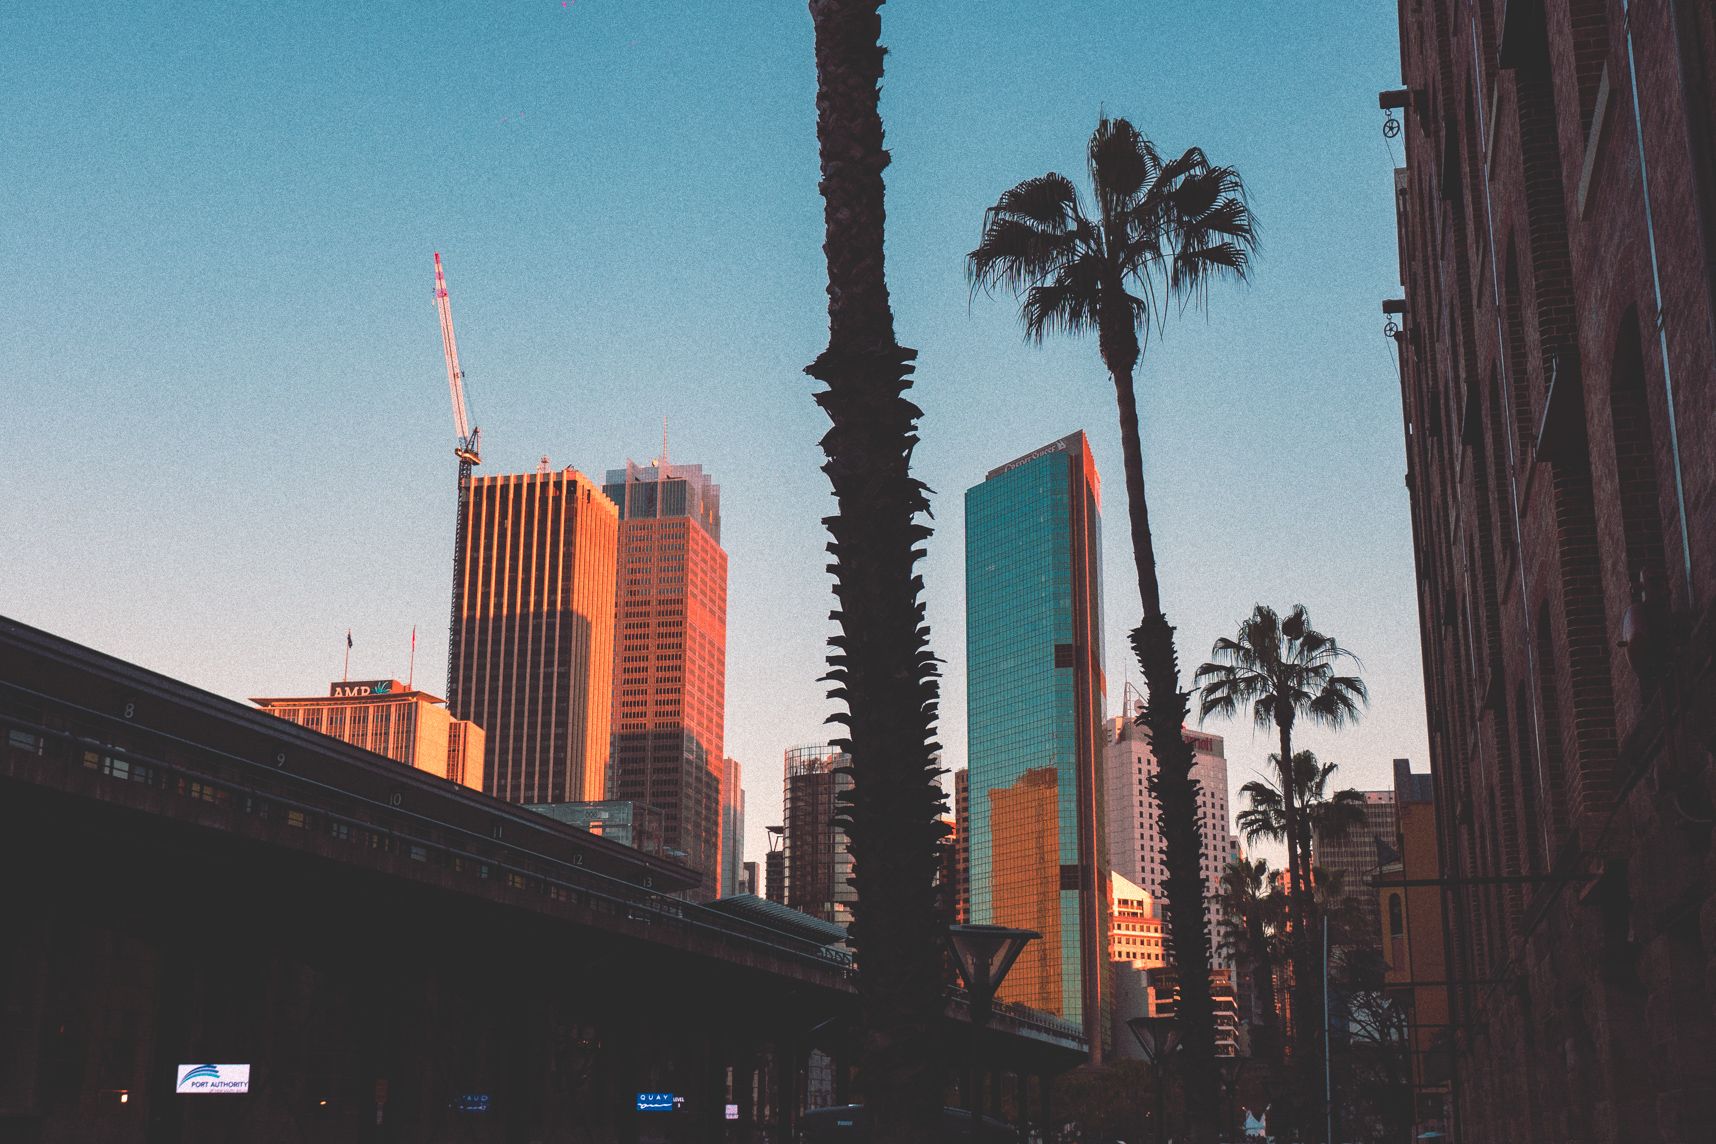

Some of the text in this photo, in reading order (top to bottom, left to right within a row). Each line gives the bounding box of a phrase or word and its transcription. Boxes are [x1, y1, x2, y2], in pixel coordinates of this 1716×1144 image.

[334, 686, 371, 697] AMP
[124, 703, 135, 719] 8
[277, 753, 286, 767] 9
[390, 792, 402, 806] 10
[494, 825, 502, 838] 11
[573, 854, 583, 865] 12
[643, 876, 653, 888] 13
